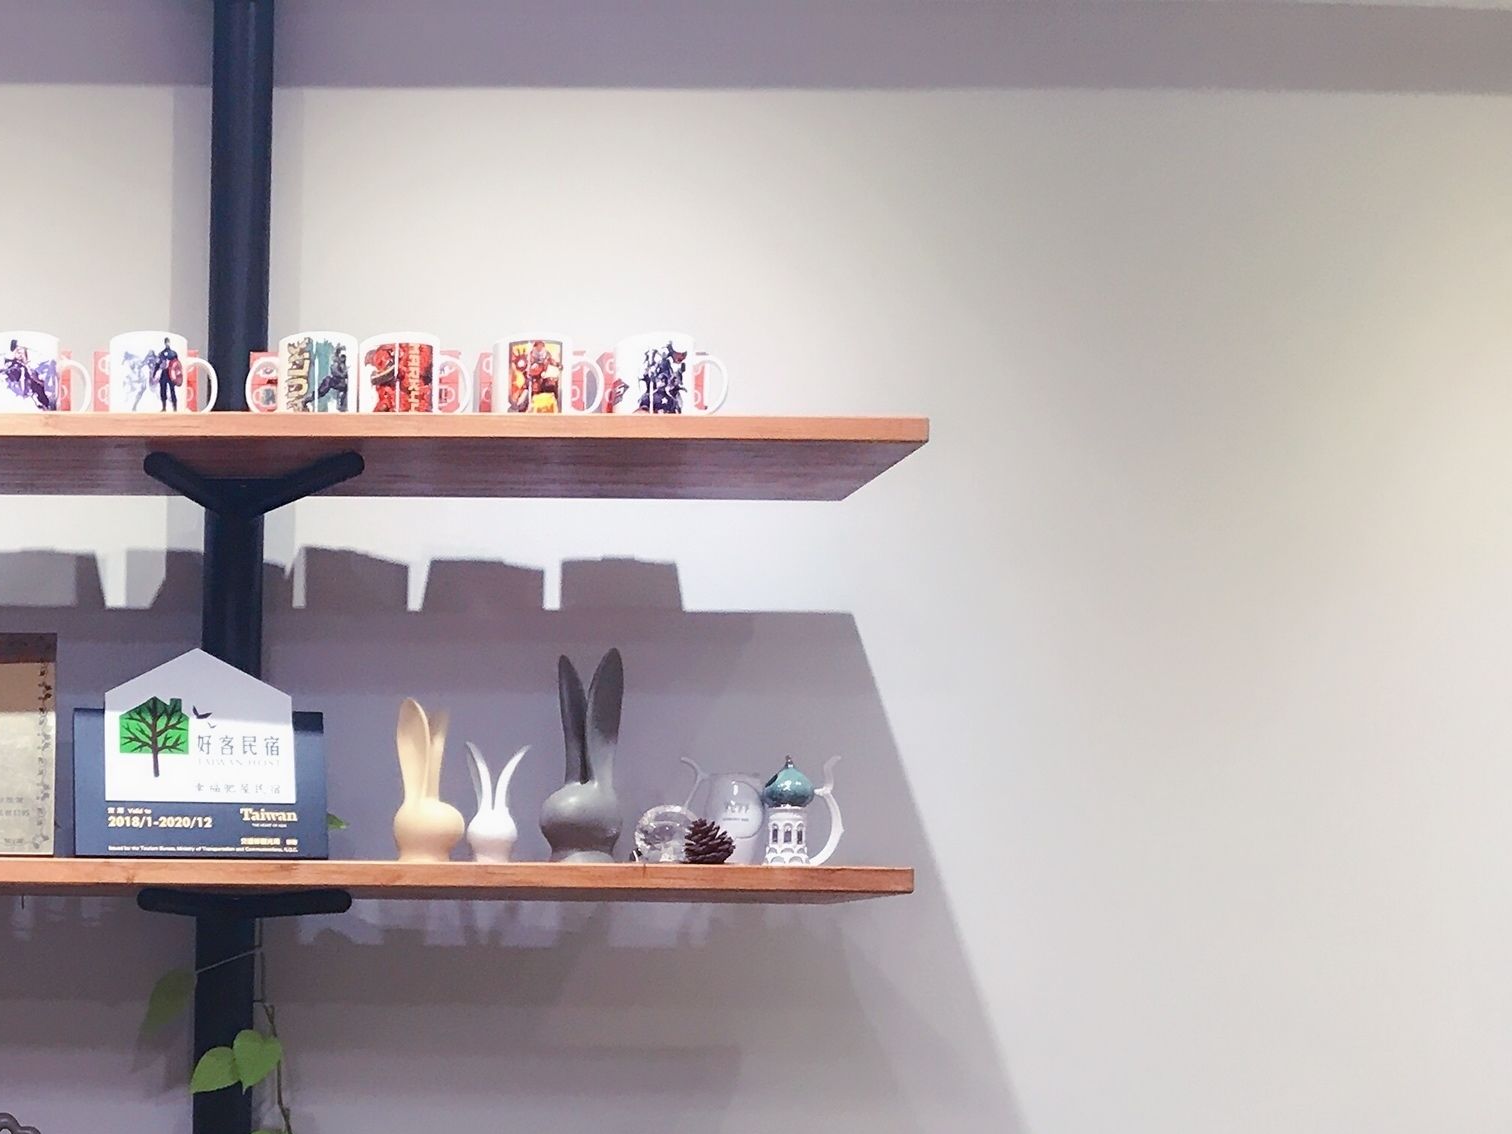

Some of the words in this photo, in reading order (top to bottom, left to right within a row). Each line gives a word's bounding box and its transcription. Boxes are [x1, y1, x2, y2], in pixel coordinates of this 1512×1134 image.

[197, 735, 280, 756] 好客民宿
[239, 808, 298, 821] Taiwan
[107, 815, 213, 829] 2018/1-2020/12
